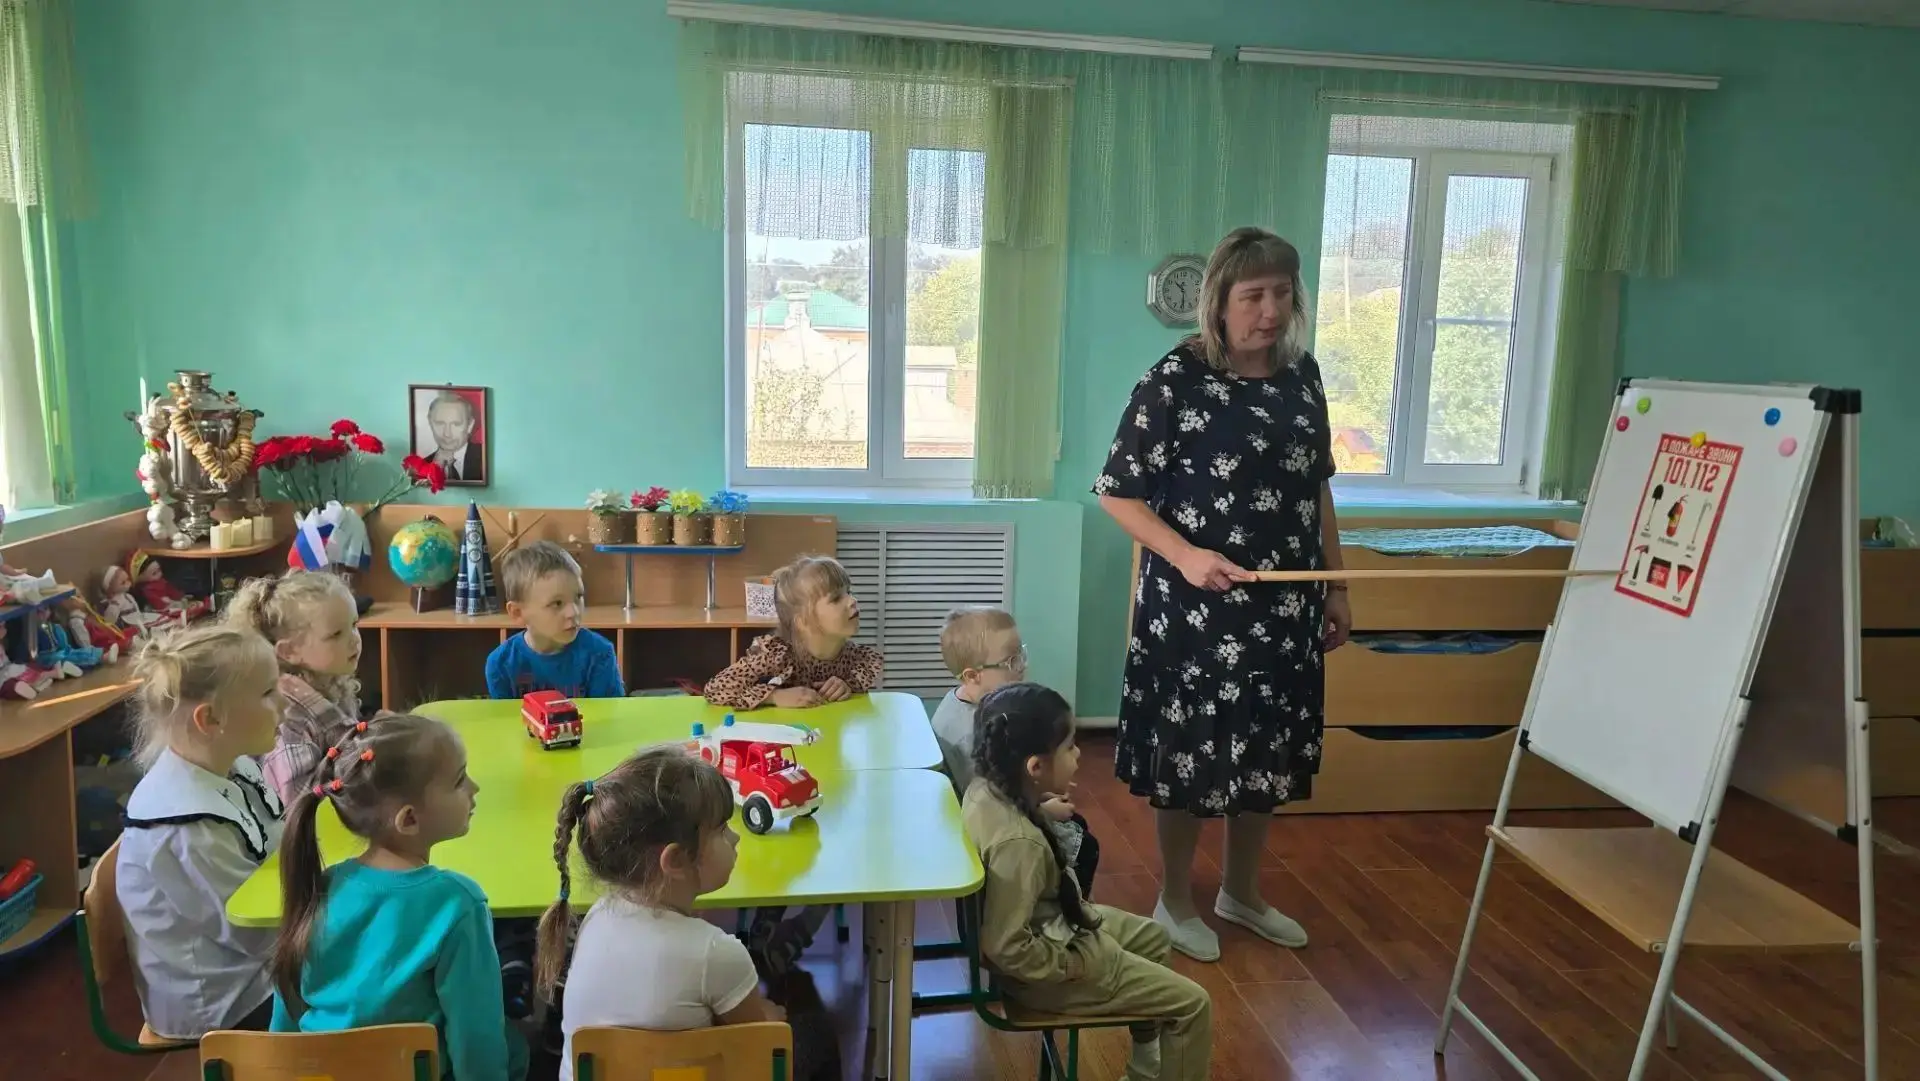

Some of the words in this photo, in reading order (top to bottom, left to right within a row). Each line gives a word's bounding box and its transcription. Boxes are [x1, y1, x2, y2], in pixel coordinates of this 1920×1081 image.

[1669, 439, 1707, 459] ПОЖАРЕ
[1706, 446, 1738, 465] ЗВОНИ
[1690, 462, 1720, 493] 112
